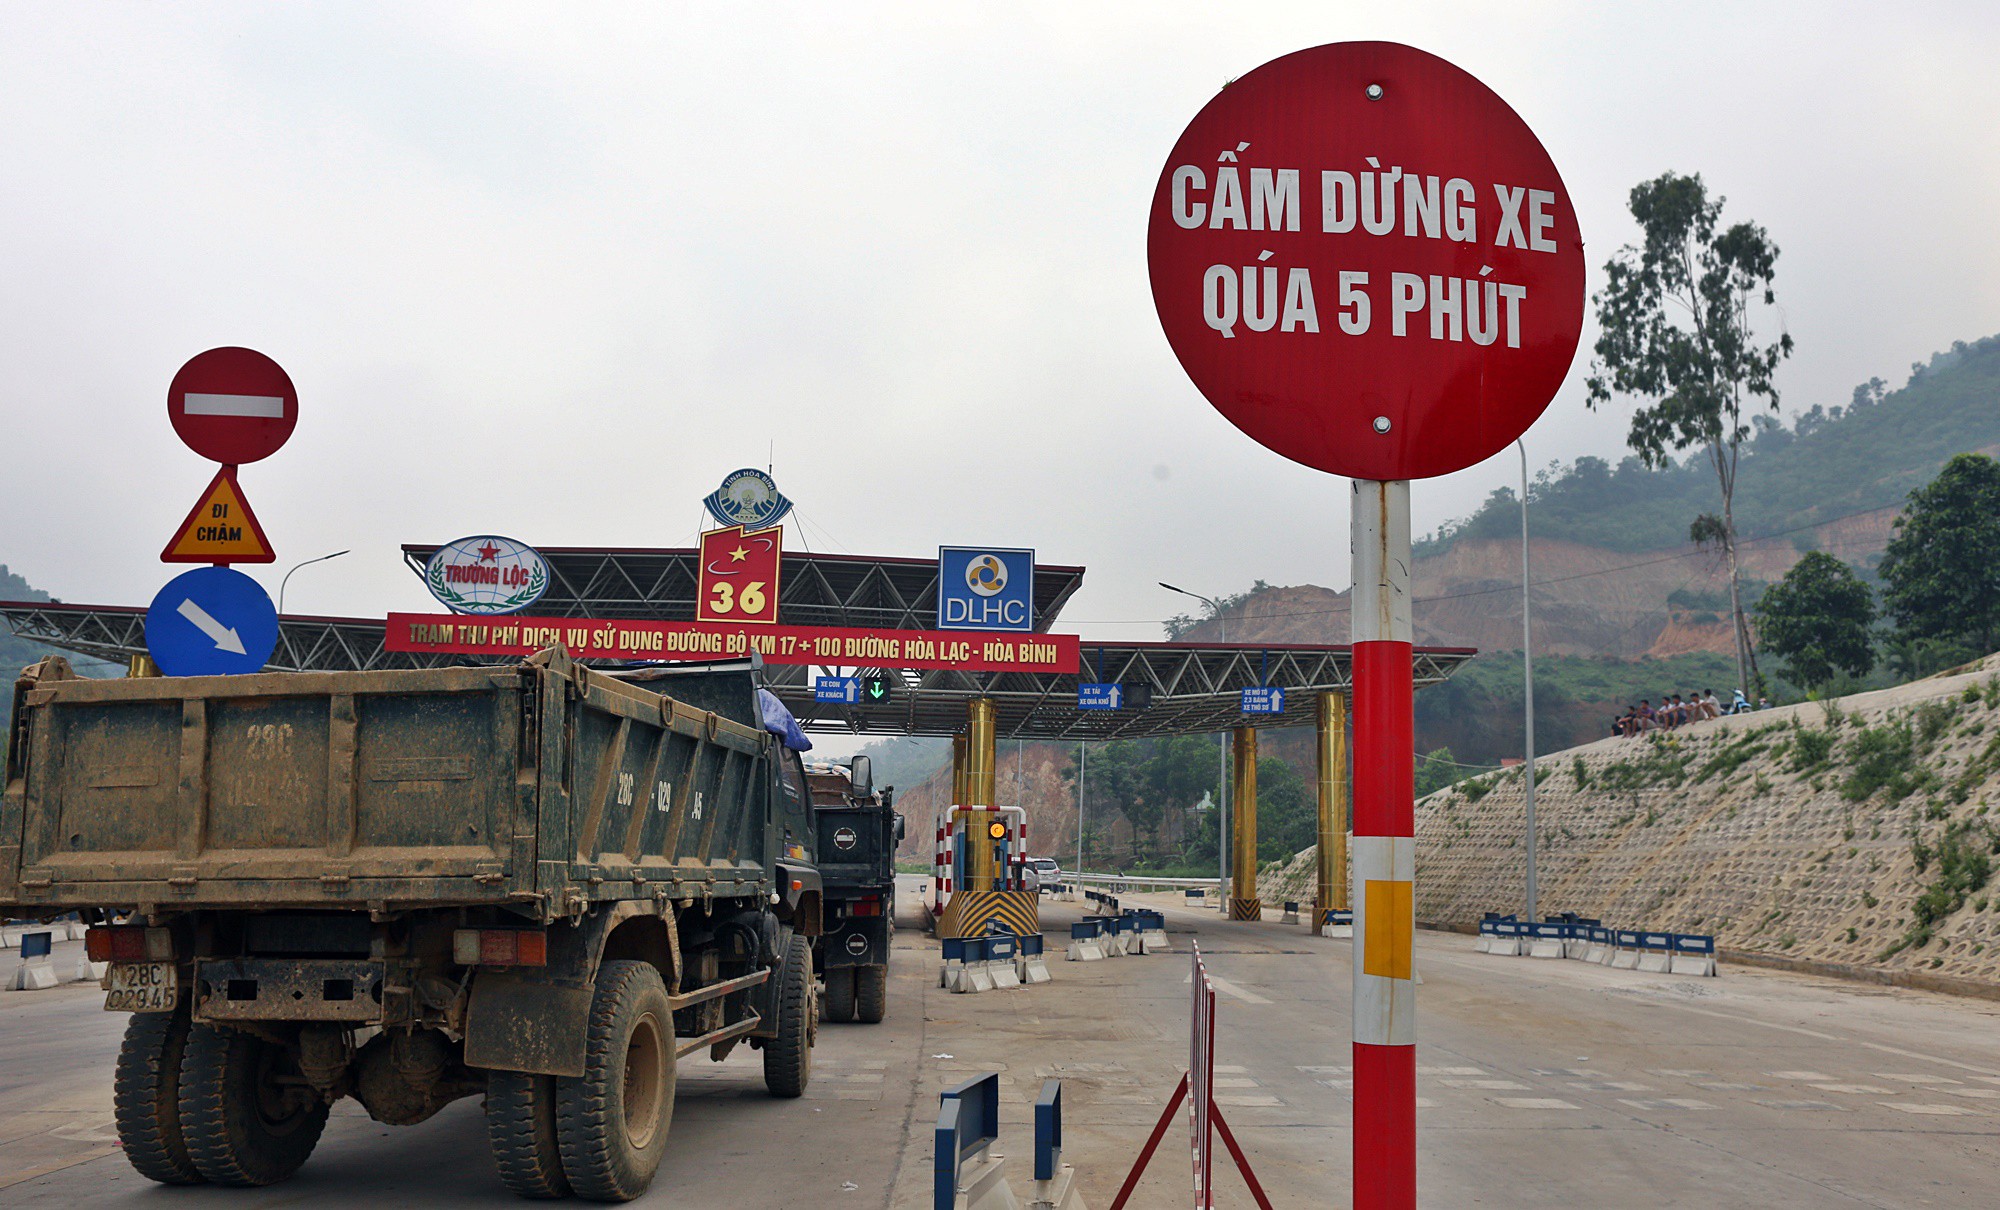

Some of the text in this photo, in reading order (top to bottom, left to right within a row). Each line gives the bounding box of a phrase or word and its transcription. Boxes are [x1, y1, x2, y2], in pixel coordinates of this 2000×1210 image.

[1171, 141, 1557, 254] CẤM DỪNG XE
[1202, 249, 1527, 349] QÚA 5 PHÚT
[211, 503, 228, 519] ĐI
[196, 523, 242, 545] CHẬM
[445, 561, 529, 589] TRƯỜNG LỘC
[709, 581, 767, 614] 36
[946, 597, 1025, 624] DLHC
[409, 623, 454, 647] TRẠM
[458, 625, 488, 645] THU
[491, 621, 519, 646] PHÍ
[522, 627, 560, 650] DỊCH
[566, 628, 588, 653] VỤ
[592, 622, 616, 650] SỬ
[619, 630, 663, 654] DỤNG
[667, 627, 722, 653] ĐƯỜNG
[726, 630, 747, 657] BỘ
[750, 634, 776, 655] KM
[845, 633, 900, 659] ĐƯỜNG
[904, 635, 936, 660] HÒA
[939, 641, 970, 665] LẠC
[983, 638, 1015, 662] HÒA
[1019, 639, 1057, 664] BÌNH
[825, 690, 844, 699] KHÁCH
[828, 680, 840, 688] CON
[617, 771, 634, 806] 28C
[657, 780, 671, 813] 029
[127, 964, 161, 986] 28C
